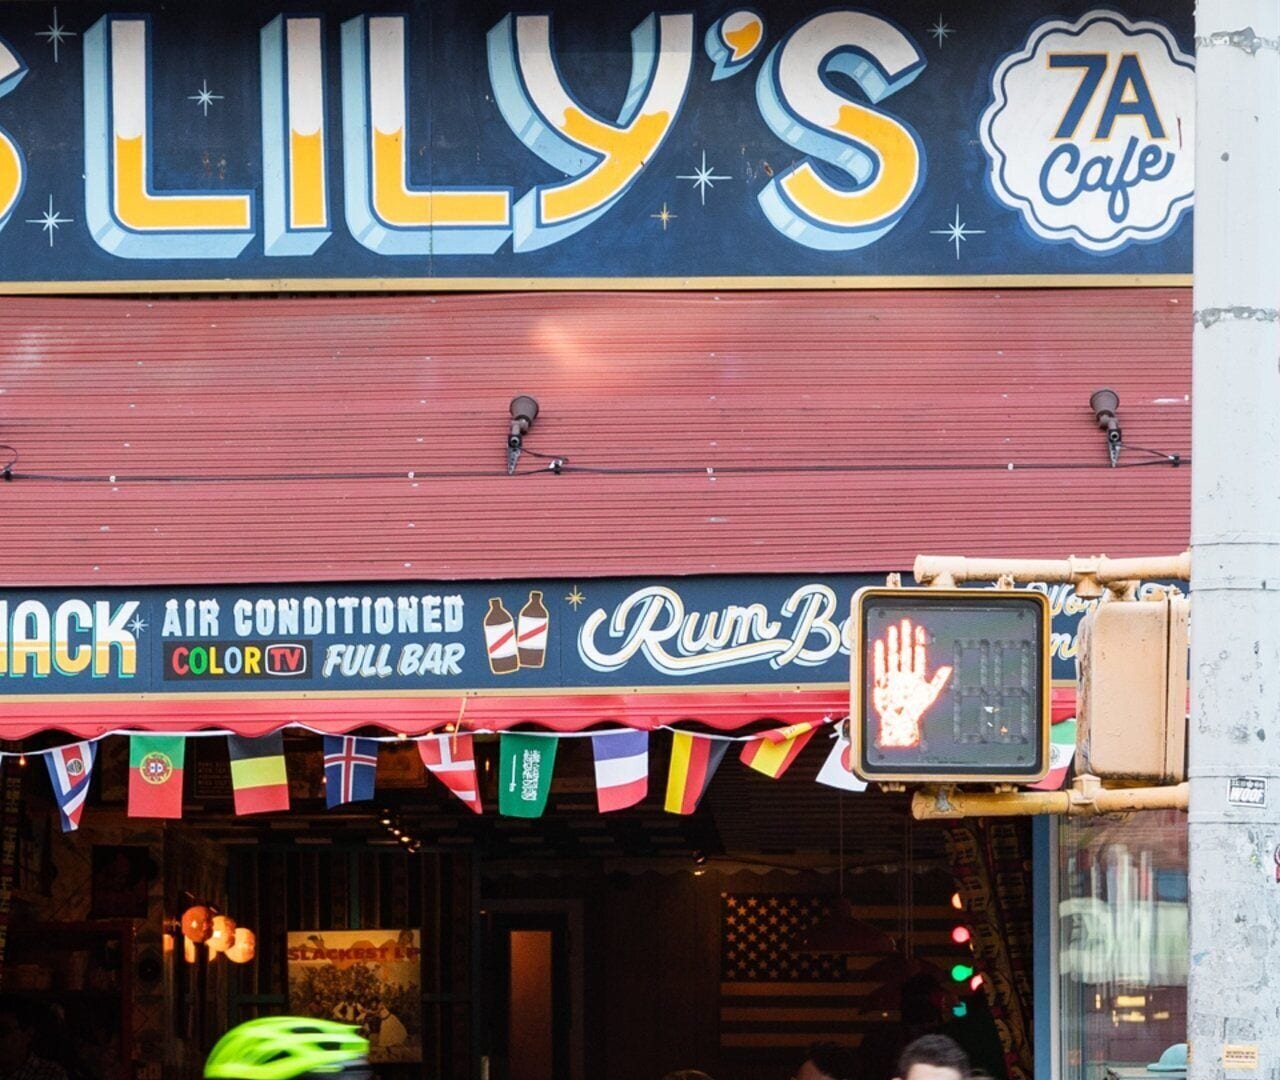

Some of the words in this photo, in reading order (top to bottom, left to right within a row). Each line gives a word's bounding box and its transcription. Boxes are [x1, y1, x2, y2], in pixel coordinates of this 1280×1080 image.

[83, 9, 926, 259] LILY'S
[1047, 52, 1169, 142] 7A
[1039, 136, 1175, 223] Cafe
[161, 598, 220, 637] AIR
[233, 594, 465, 636] CONDITIONED
[578, 585, 792, 676] Rum
[172, 646, 261, 676] COLOR
[270, 648, 302, 671] TV
[322, 643, 392, 678] FULL
[397, 642, 466, 678] BAR
